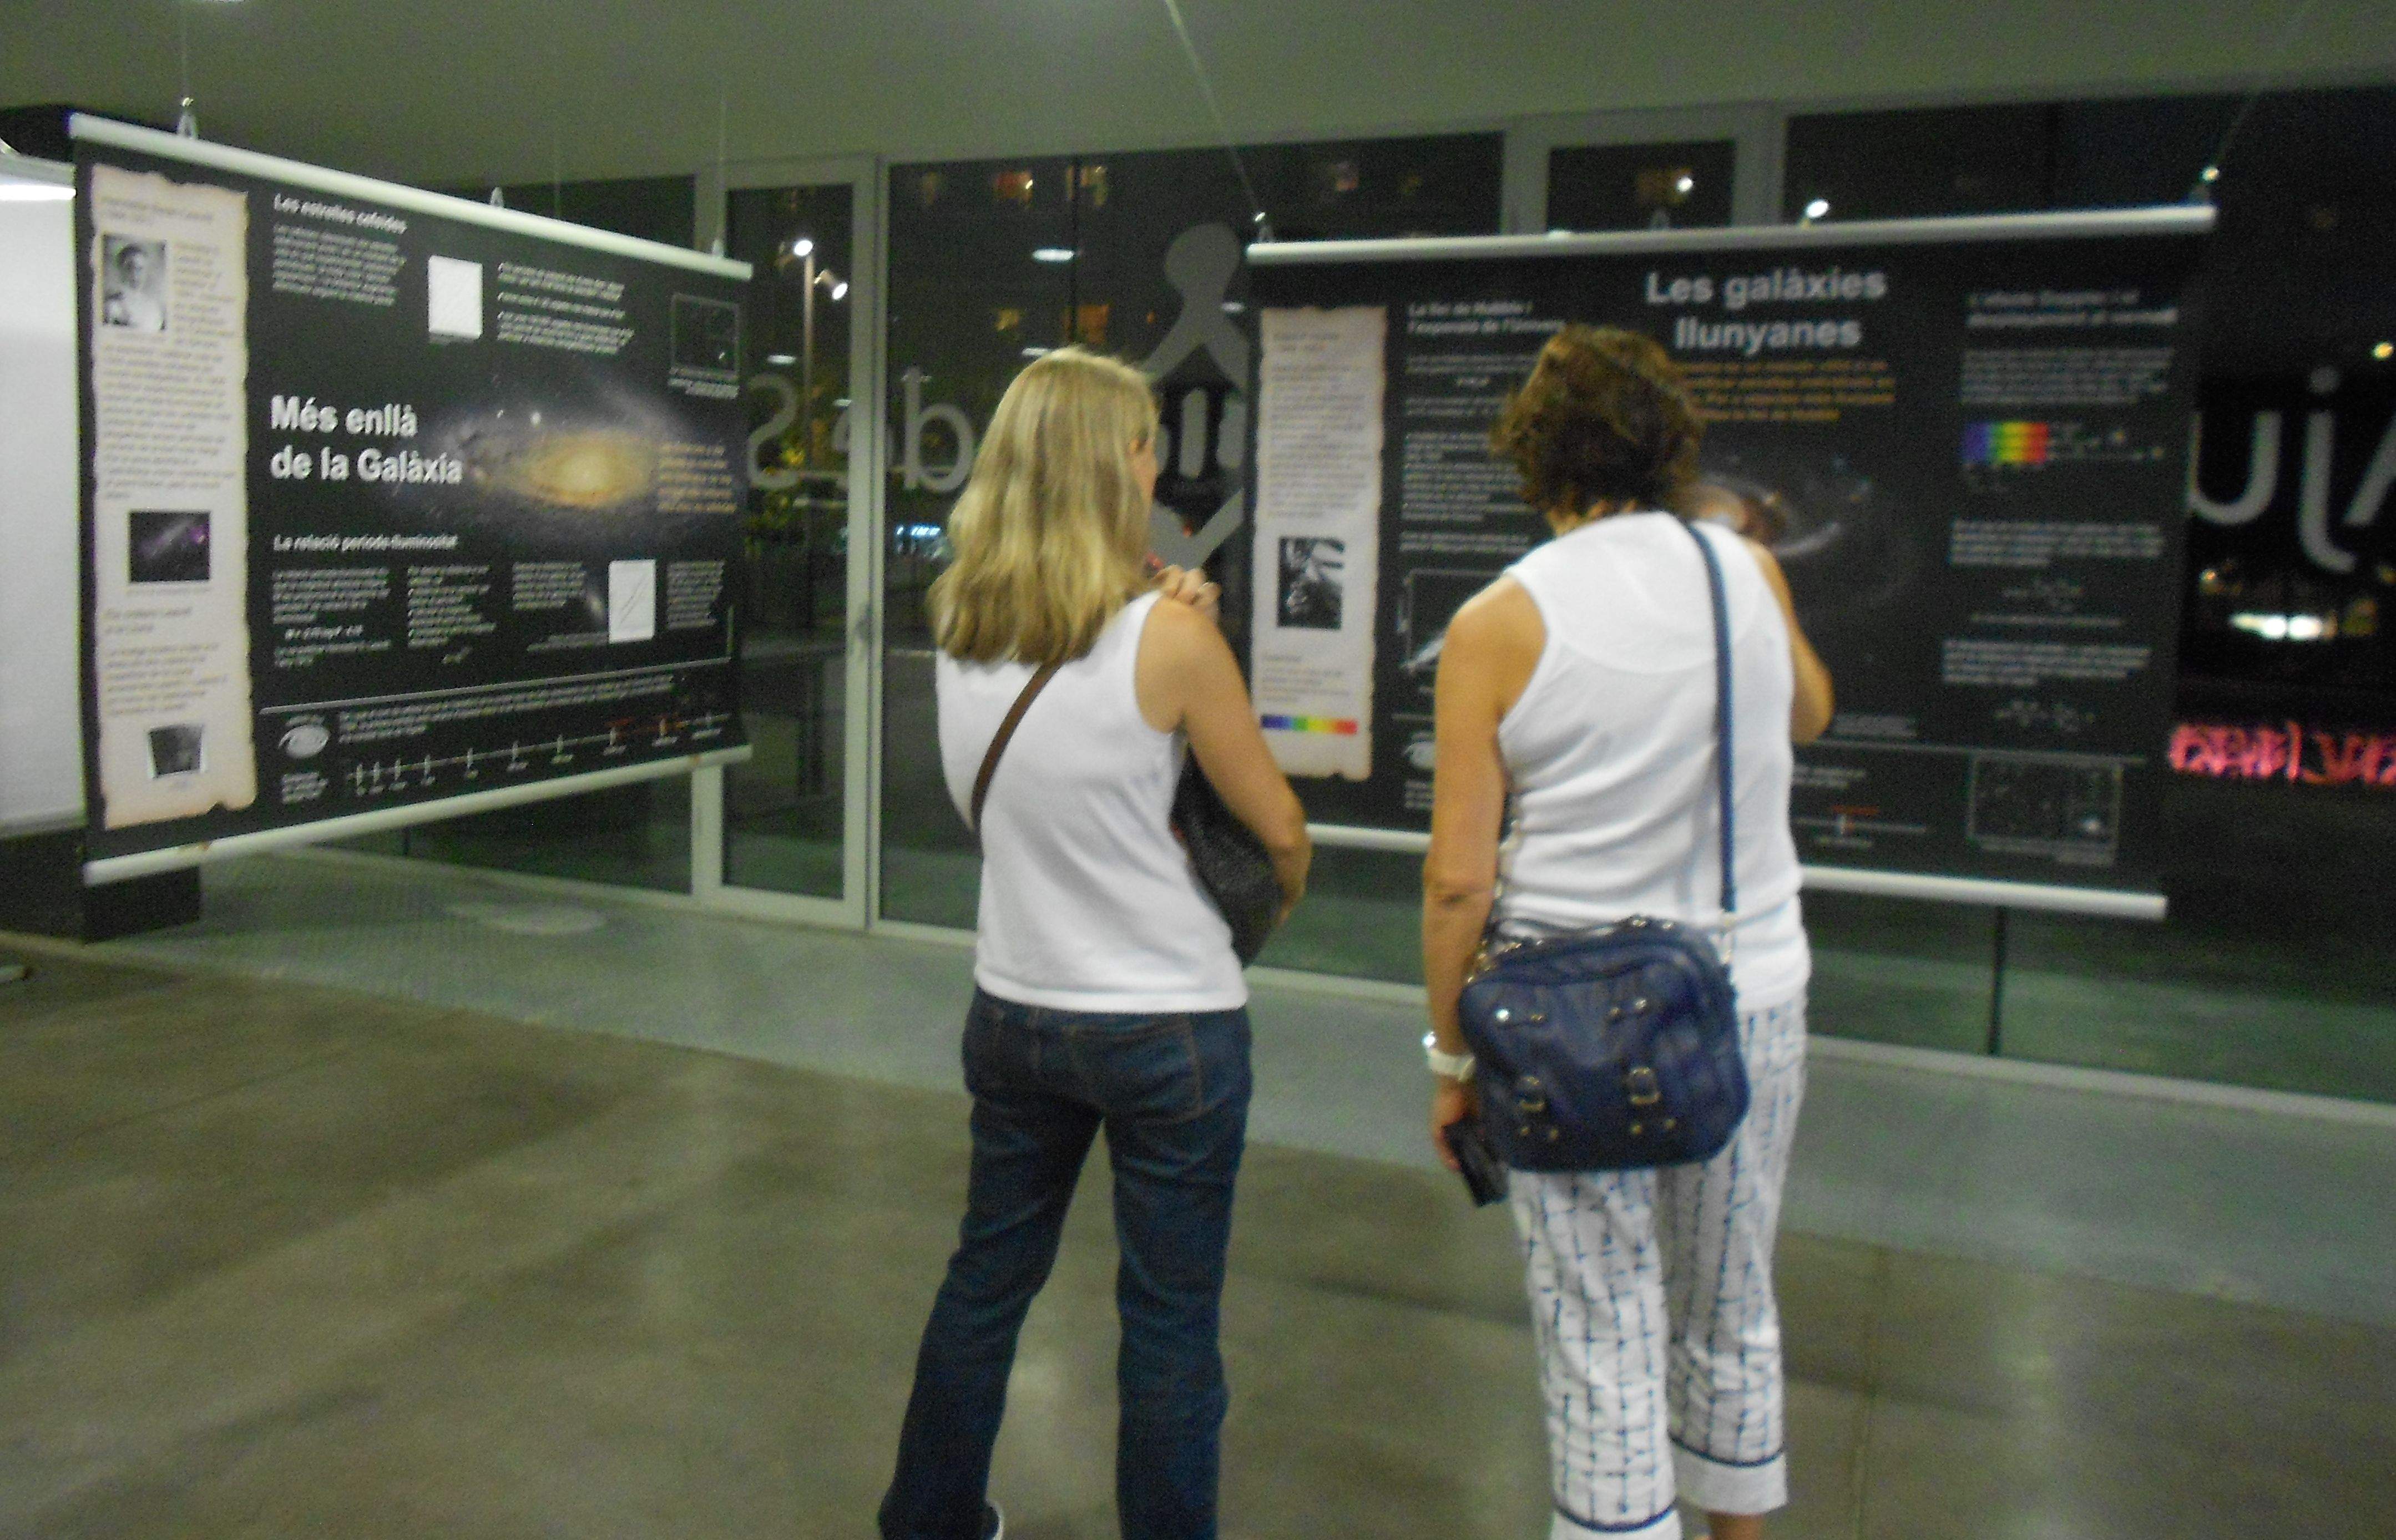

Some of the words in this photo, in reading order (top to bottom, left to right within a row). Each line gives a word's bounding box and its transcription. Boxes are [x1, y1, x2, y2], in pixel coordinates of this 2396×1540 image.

[1646, 270, 1714, 305] Les
[1722, 266, 1887, 311] galàxies
[1674, 316, 1863, 357] llunyanes
[270, 394, 338, 433] Més
[345, 403, 418, 437] enllà
[270, 444, 313, 480] de
[320, 446, 351, 481] la
[357, 447, 463, 484] Galàxia
